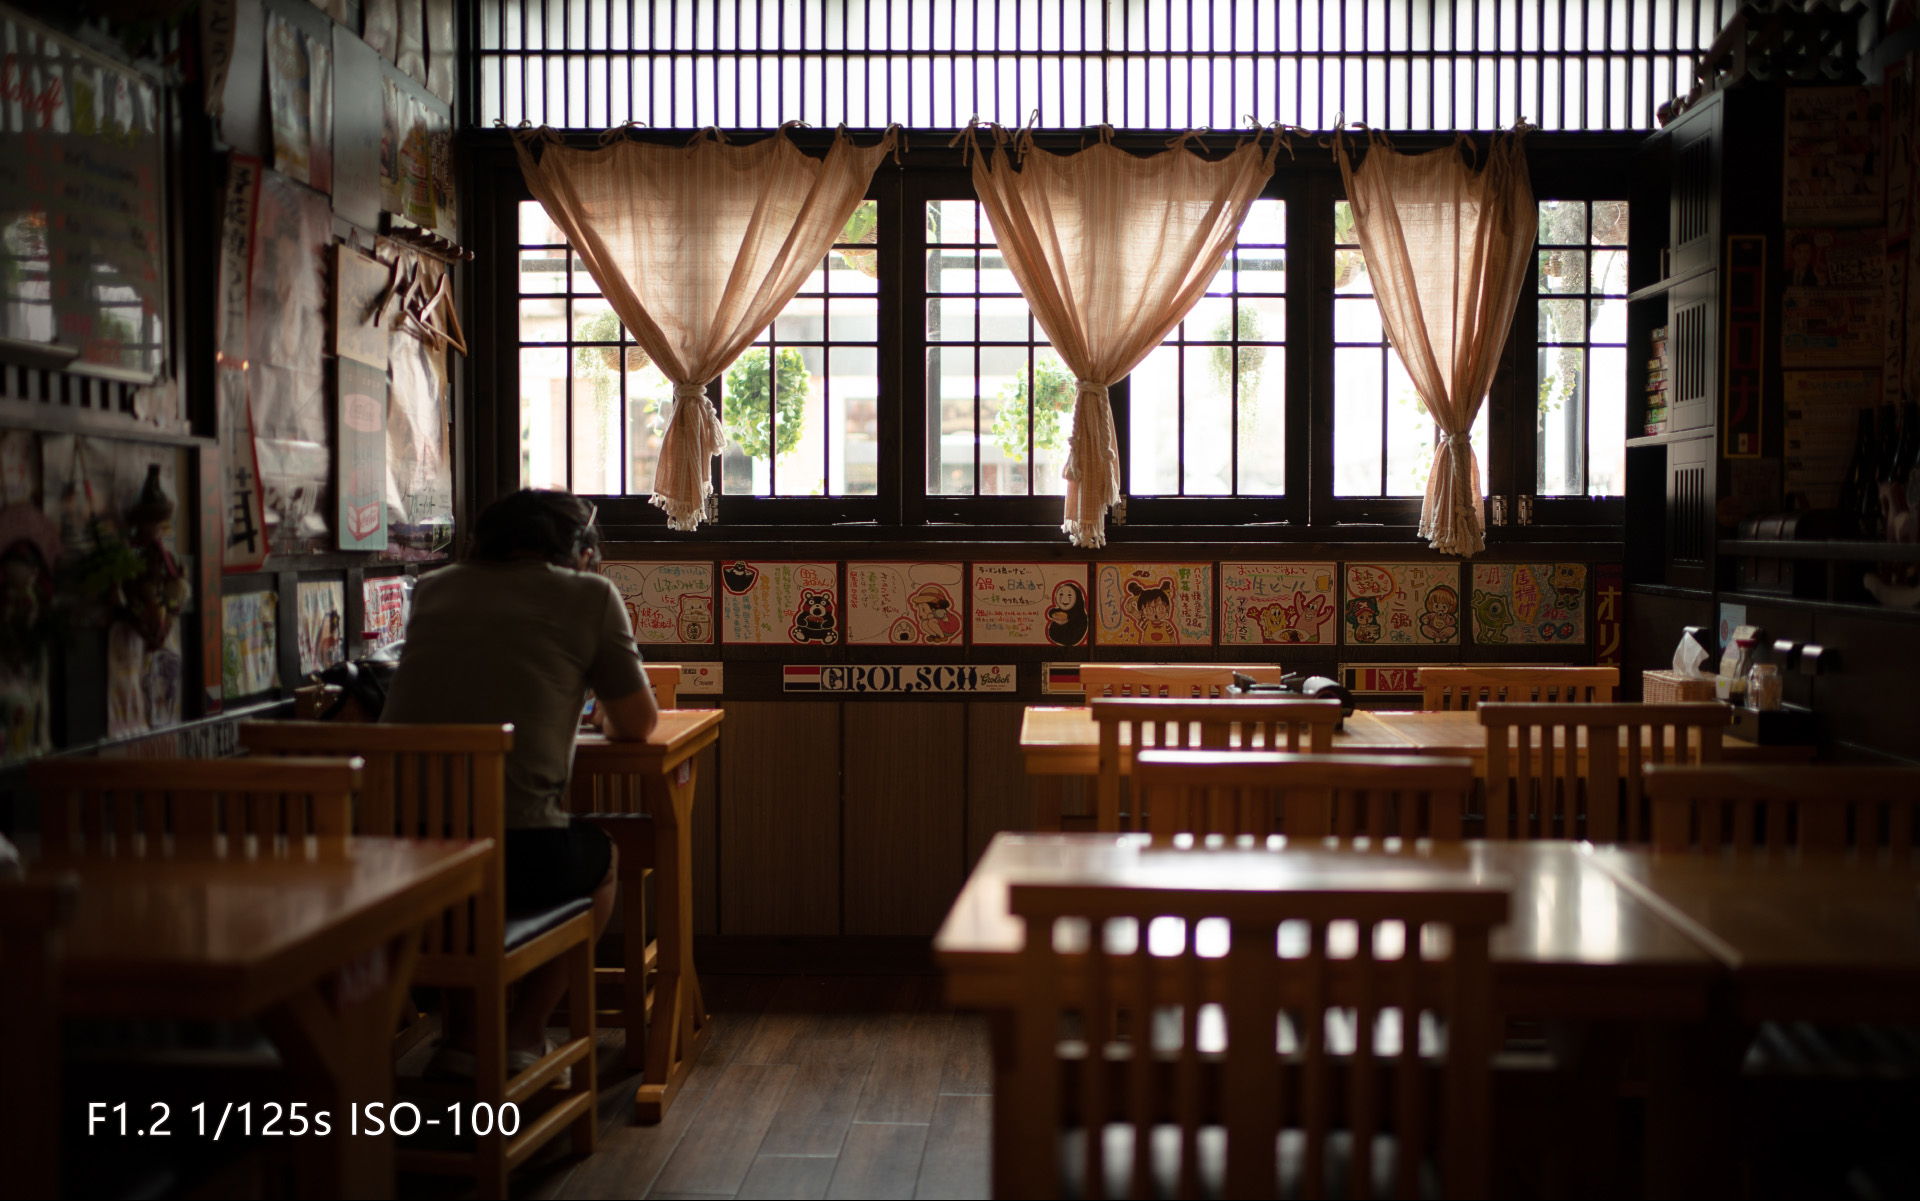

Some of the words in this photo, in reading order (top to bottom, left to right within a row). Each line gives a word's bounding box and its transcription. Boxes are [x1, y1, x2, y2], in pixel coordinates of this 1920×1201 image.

[1886, 264, 1902, 396] とうもろこ
[1252, 576, 1311, 596] 生ビール
[1410, 567, 1425, 602] カレー
[1390, 586, 1412, 629] カニ鍋
[1597, 585, 1623, 668] オリ
[980, 672, 1011, 686] Grolsch
